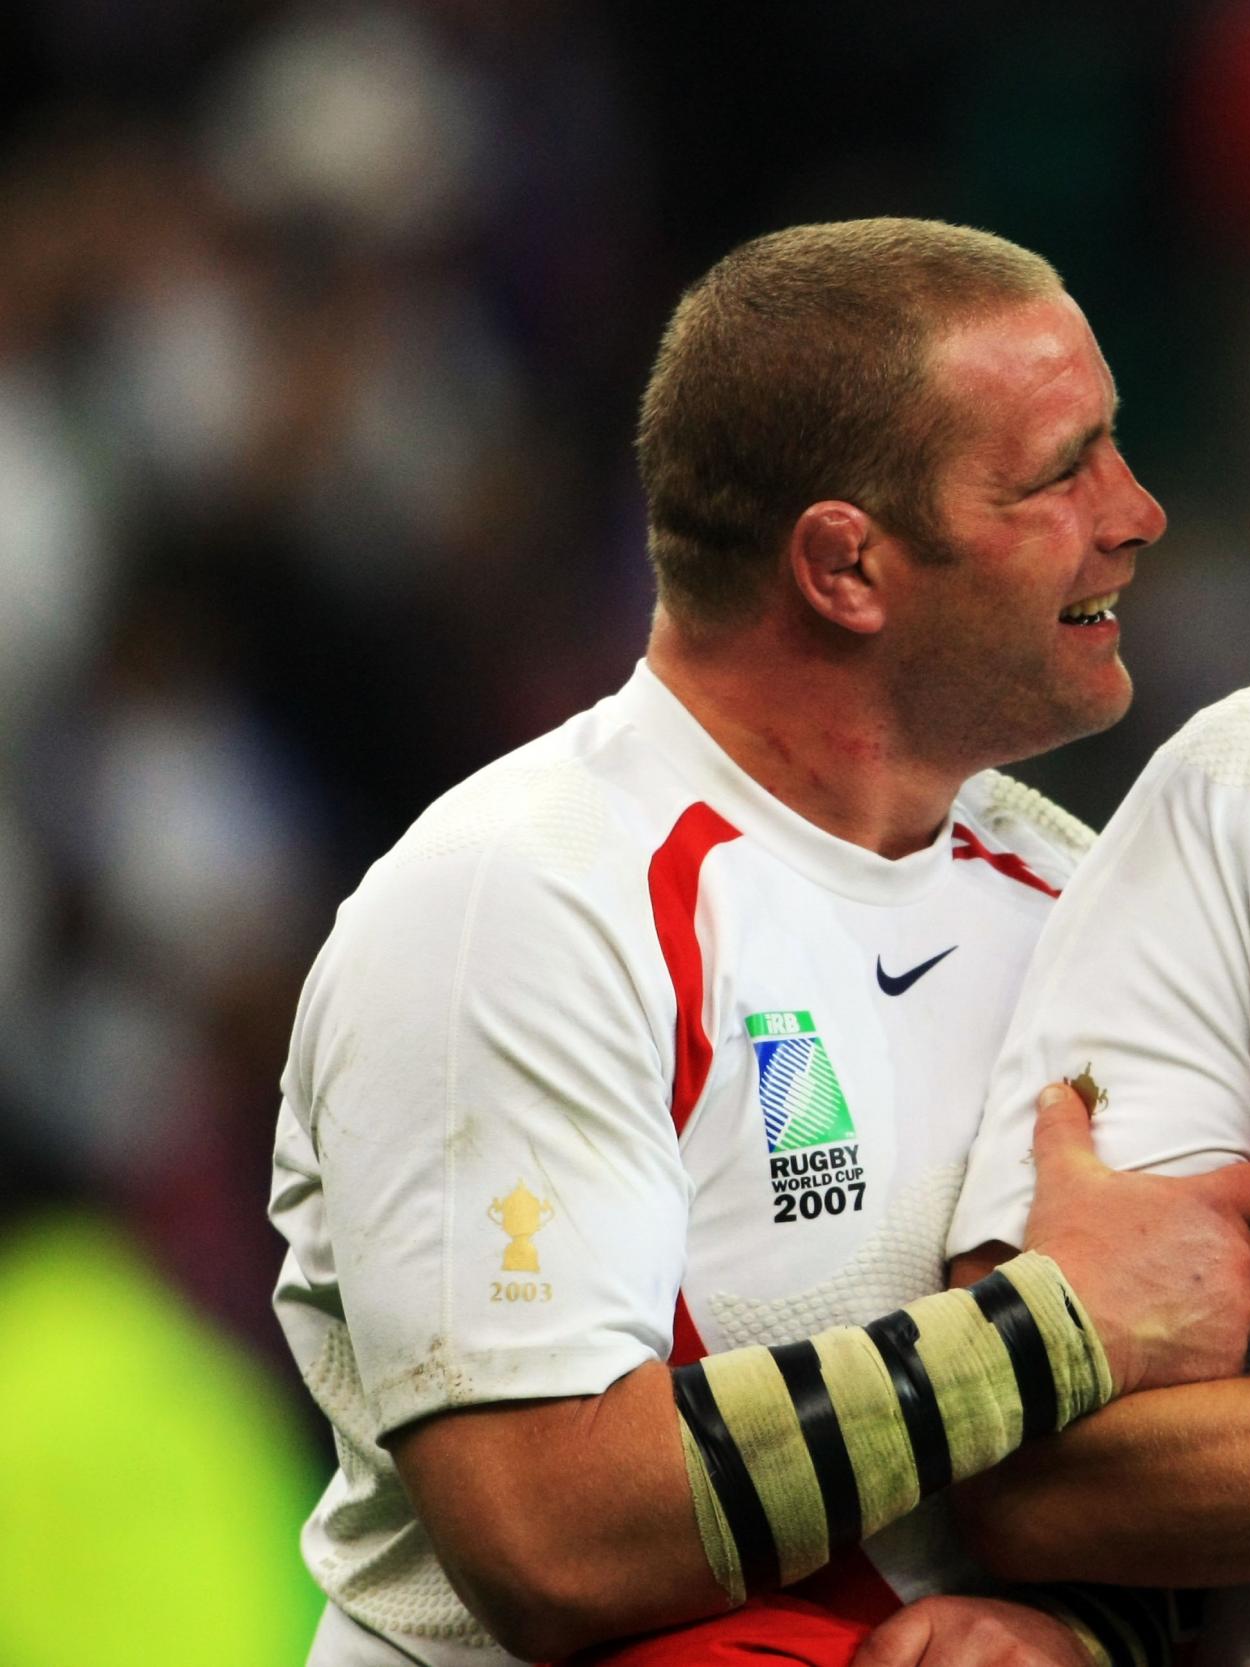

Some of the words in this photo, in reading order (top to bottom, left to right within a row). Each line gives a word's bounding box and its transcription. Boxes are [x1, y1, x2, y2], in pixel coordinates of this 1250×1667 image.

[770, 1145, 859, 1179] RUGBY
[772, 1173, 832, 1193] WORLD
[835, 1167, 864, 1184] CUP
[774, 1182, 866, 1223] 2007
[490, 1282, 553, 1302] 2003
